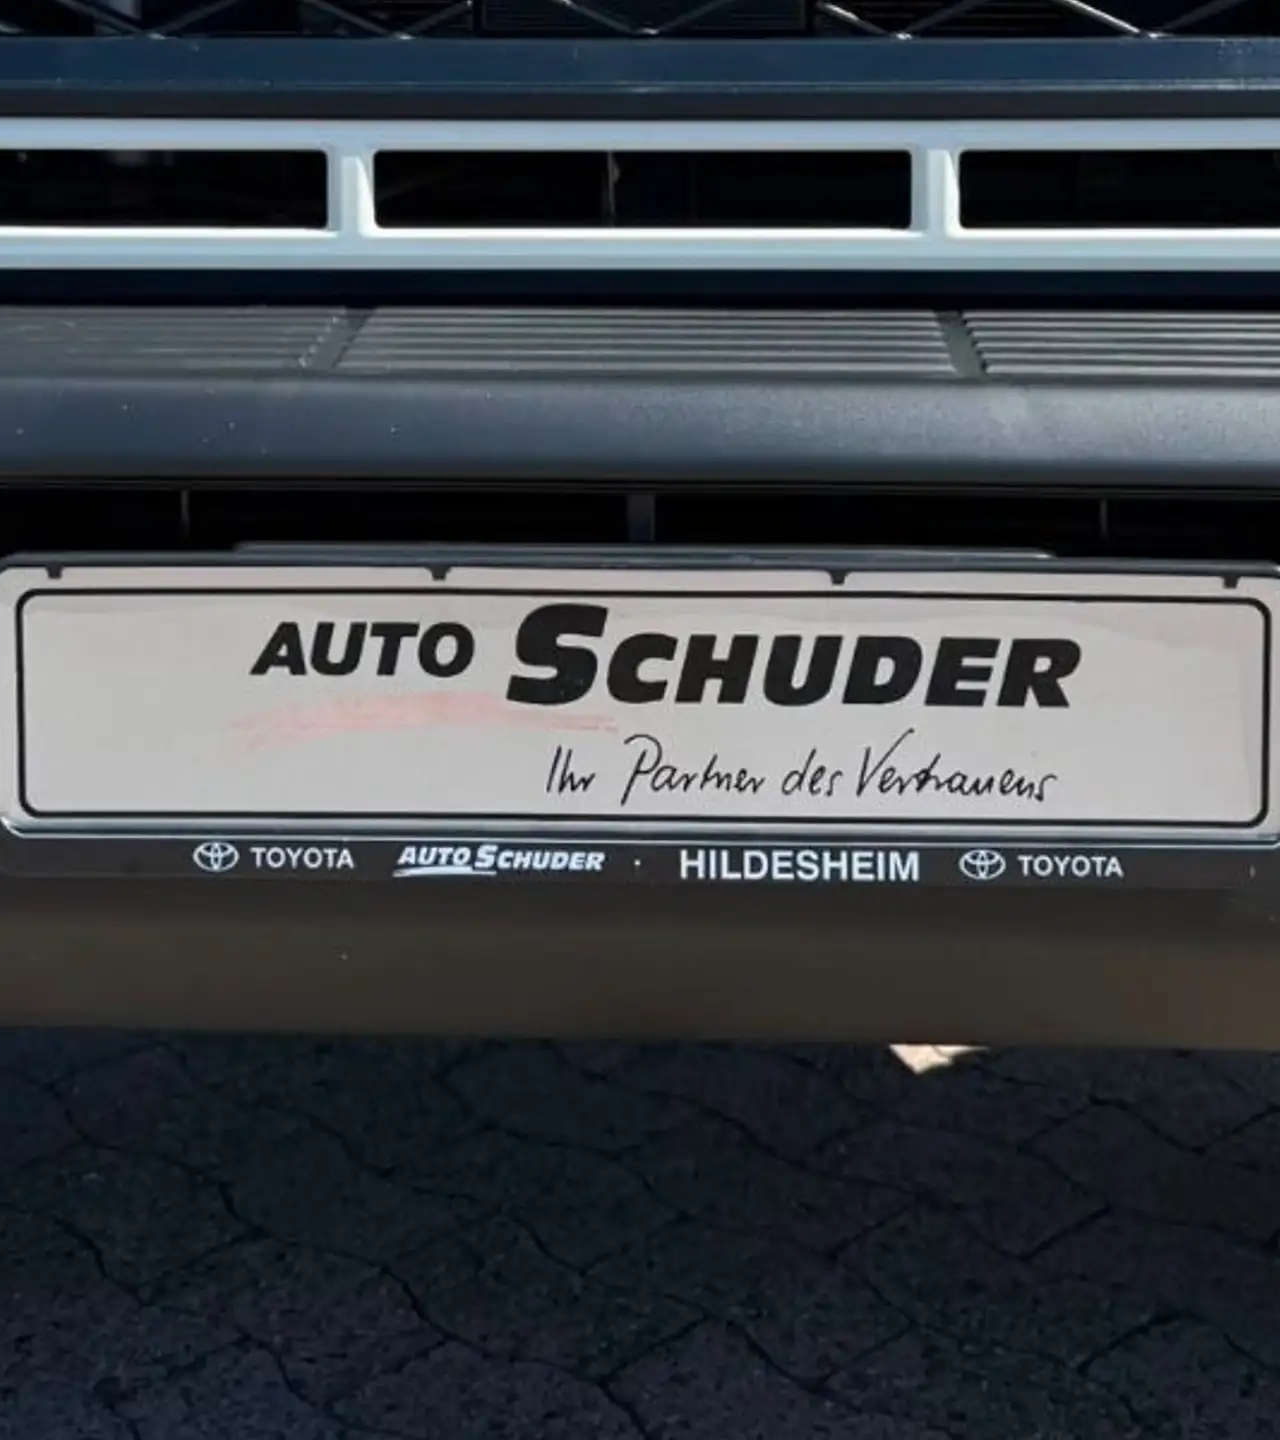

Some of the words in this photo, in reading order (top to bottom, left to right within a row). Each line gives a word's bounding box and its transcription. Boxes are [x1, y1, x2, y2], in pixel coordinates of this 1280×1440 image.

[250, 621, 476, 678] AUTO
[506, 602, 1083, 709] SCHUDER
[545, 744, 596, 795] Ihr
[620, 732, 766, 807] Partner
[780, 748, 844, 799] des
[855, 727, 1059, 803] Vertrauens
[250, 846, 356, 870] TOYOTA
[398, 846, 471, 867] AUTO
[473, 844, 606, 872] SCHUDER
[679, 849, 920, 883] HILDESHEIM
[1017, 854, 1125, 879] TOYOTA
